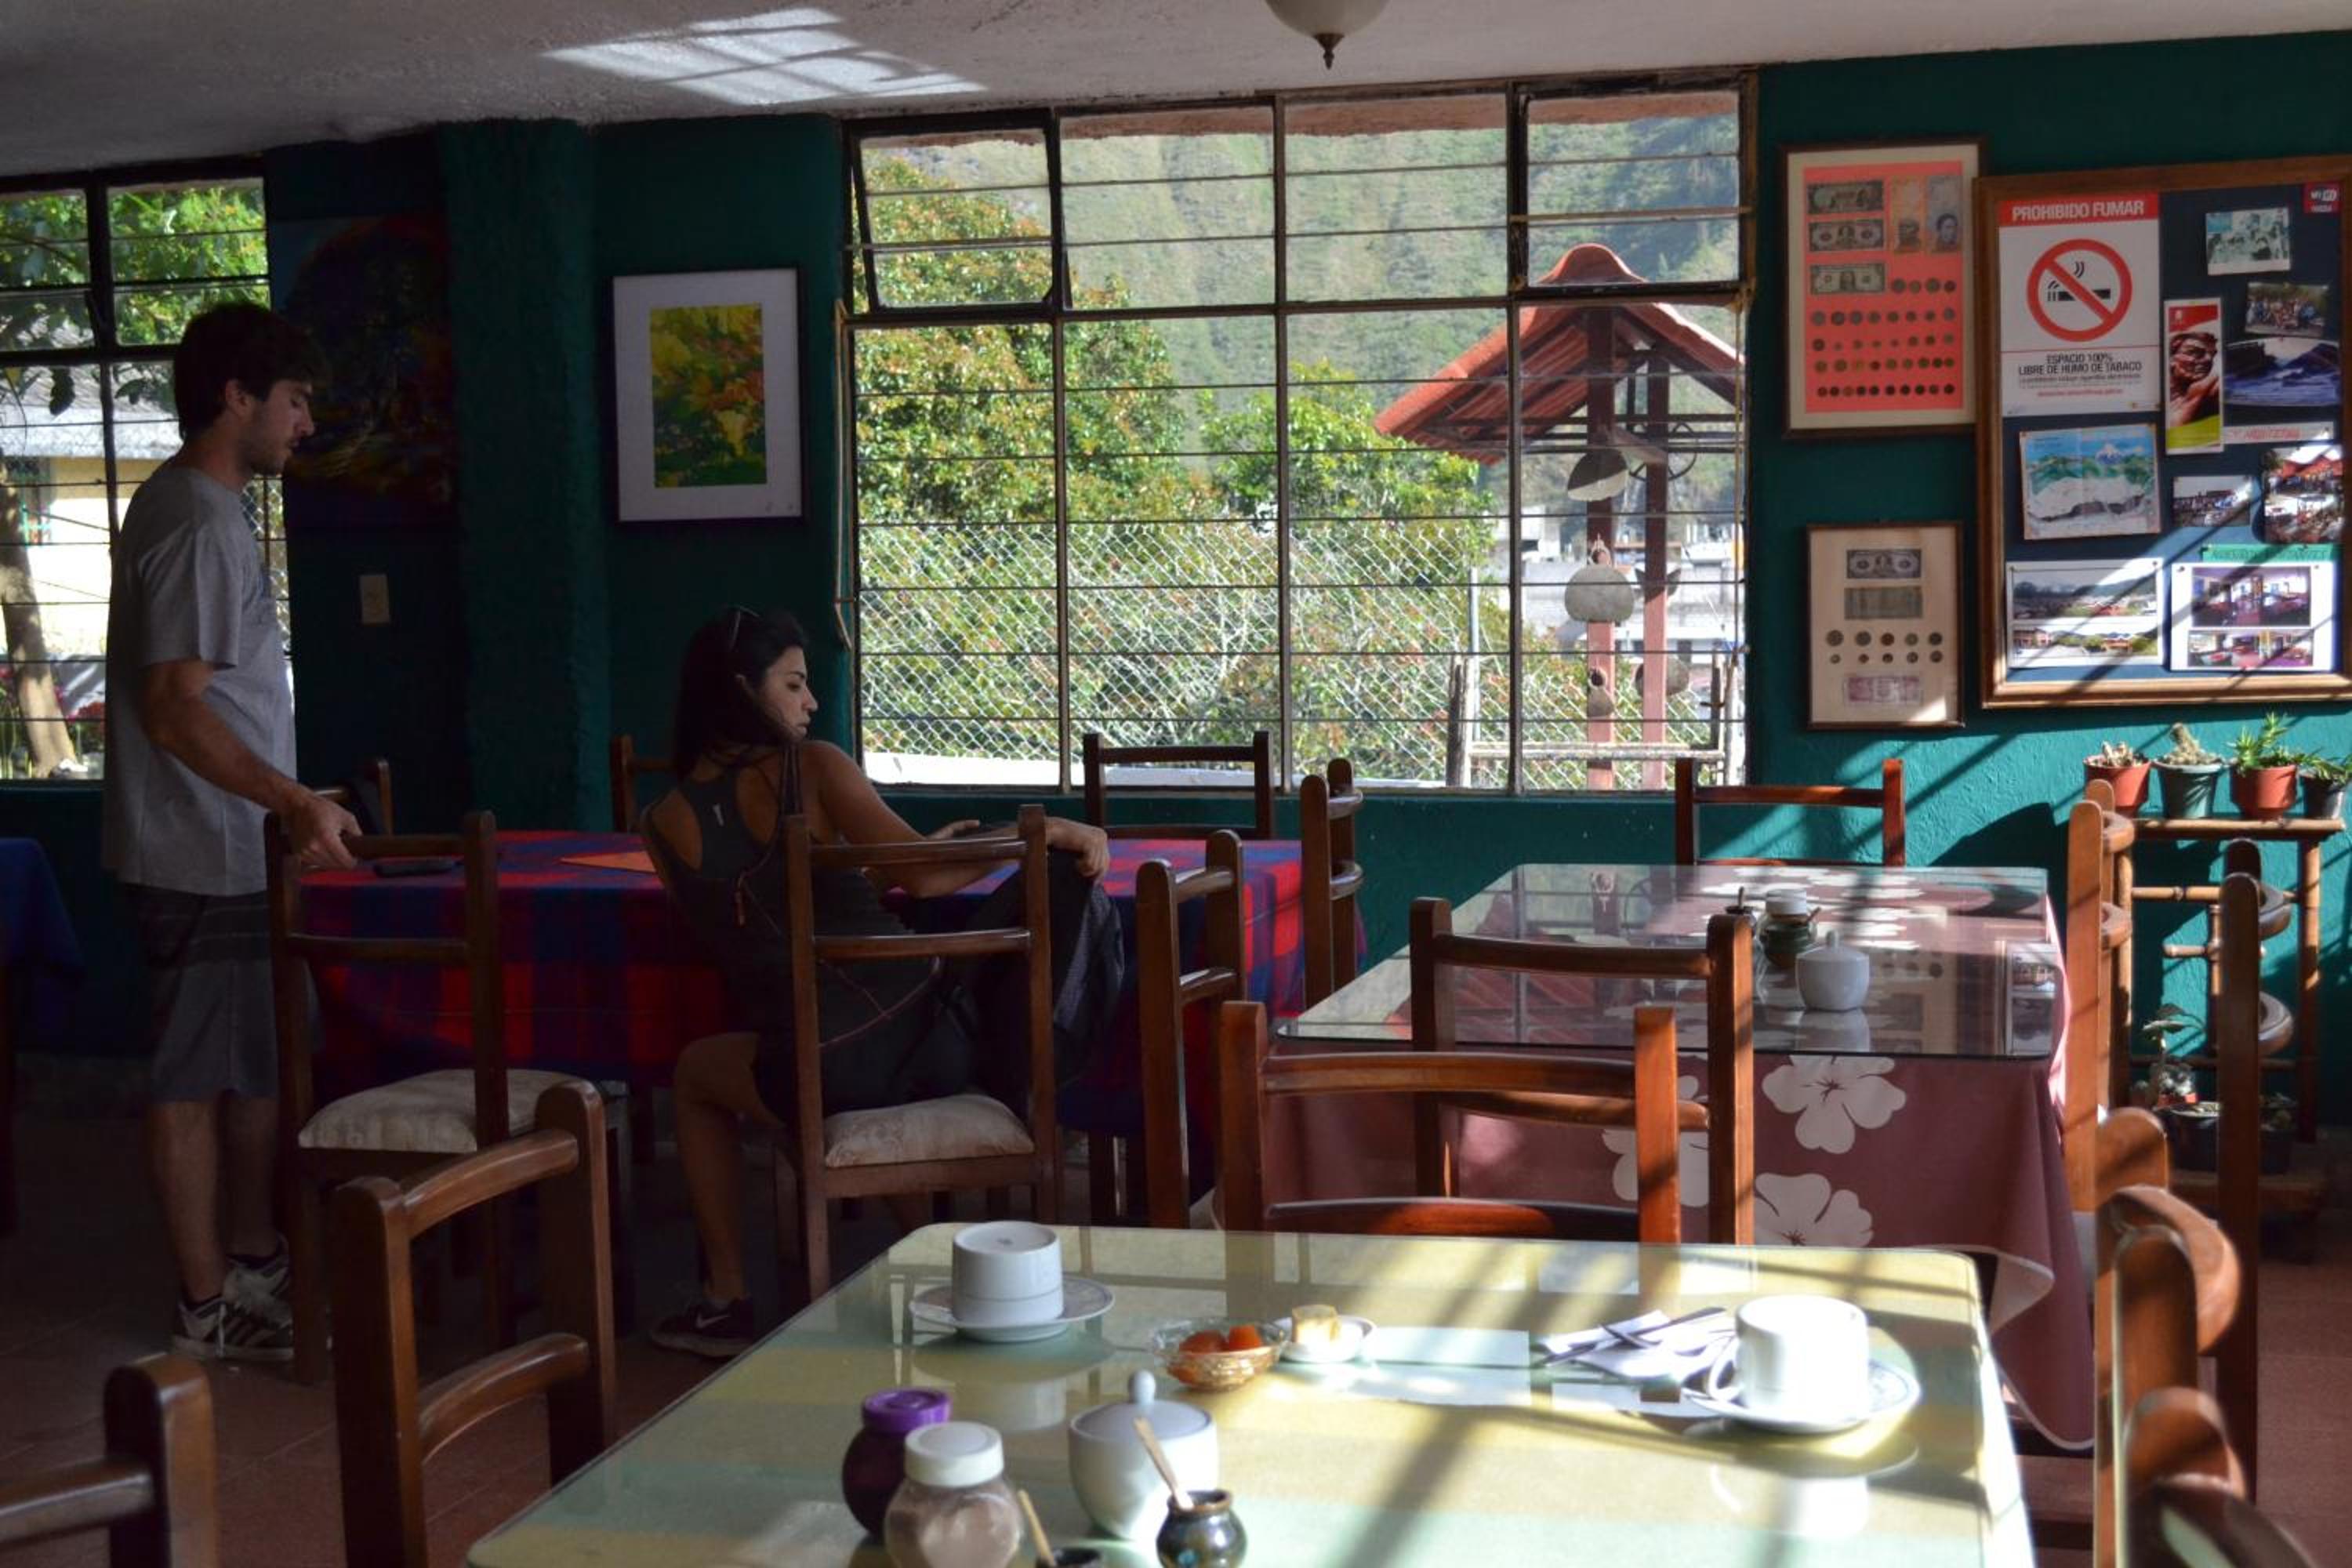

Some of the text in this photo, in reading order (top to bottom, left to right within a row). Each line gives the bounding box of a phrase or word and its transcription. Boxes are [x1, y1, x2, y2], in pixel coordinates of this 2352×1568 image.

[2012, 201, 2145, 221] PROHIBIDO FUMAR
[2046, 353, 2114, 364] ESPACIO 100%
[2019, 361, 2143, 376] LIBRE DE HUMO DE TABACO
